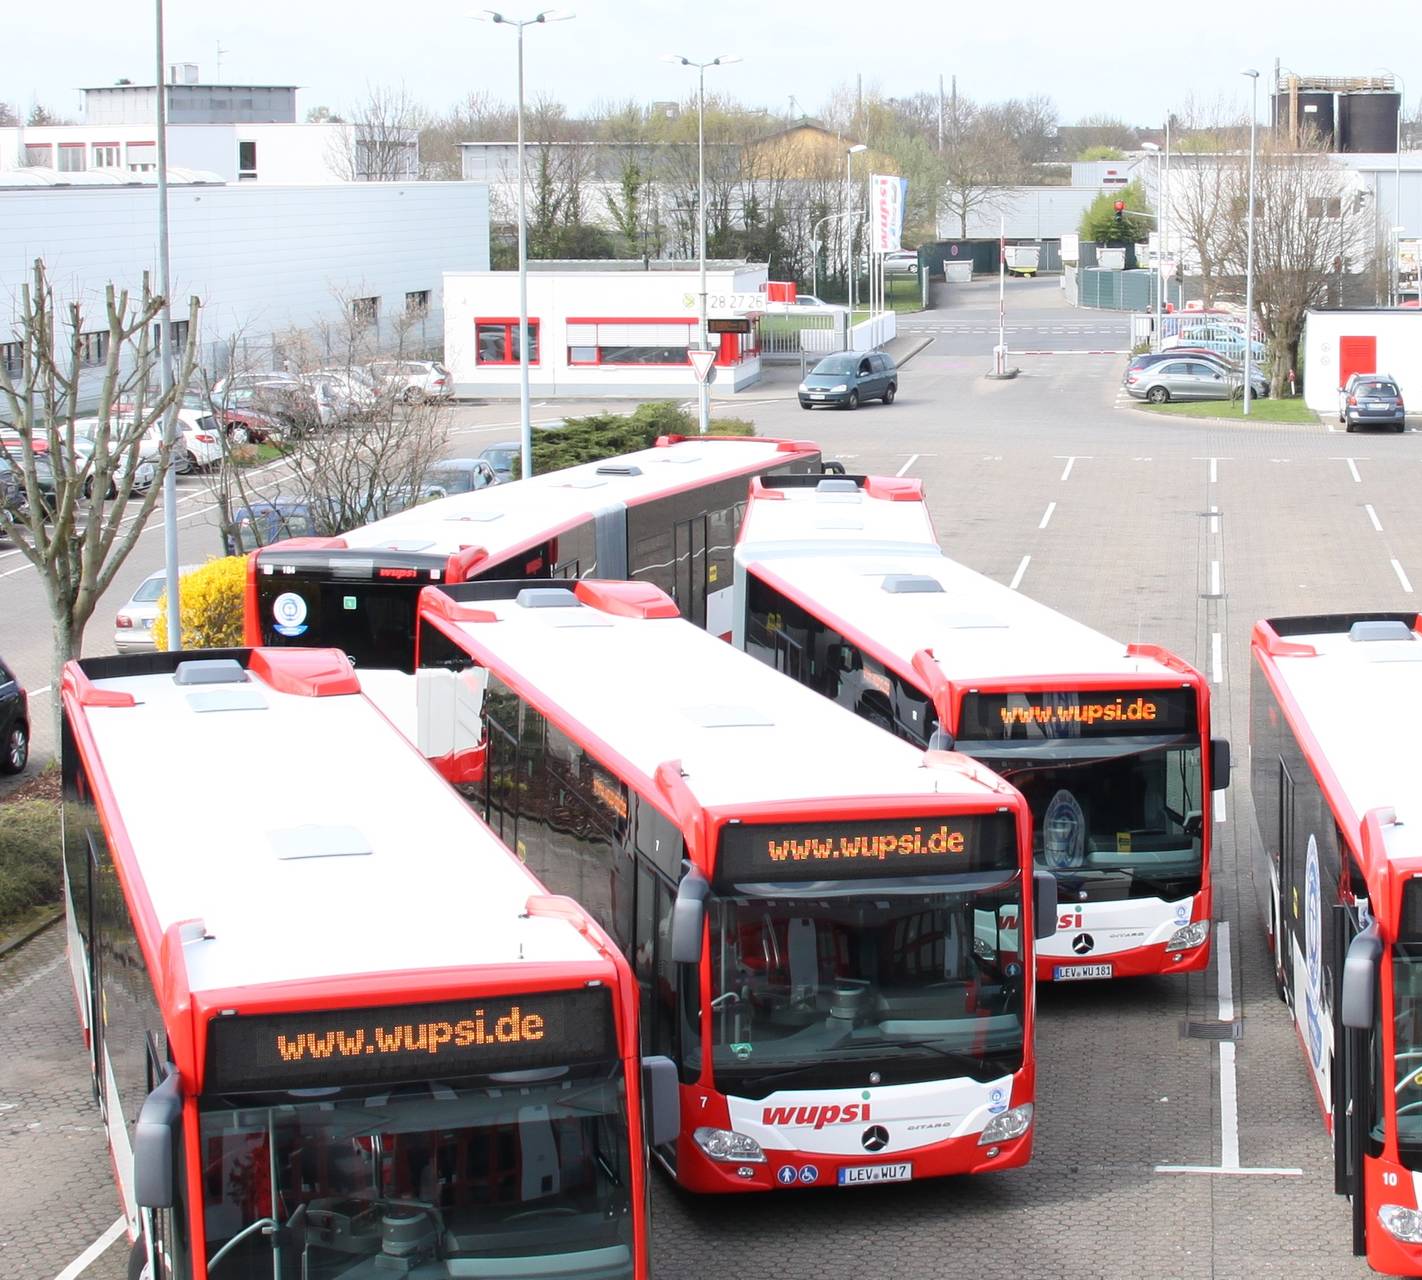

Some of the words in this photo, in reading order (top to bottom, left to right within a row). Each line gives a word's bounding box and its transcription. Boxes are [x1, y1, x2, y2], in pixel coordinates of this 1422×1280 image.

[710, 295, 726, 309] 28
[729, 295, 745, 309] 27
[748, 294, 763, 308] 26
[379, 566, 418, 580] wupsi
[1000, 697, 1157, 725] www.wupsi.de
[768, 825, 965, 861] www.wupsi.de
[1059, 967, 1076, 979] LEV
[1083, 967, 1094, 977] WU
[1095, 965, 1111, 976] 181
[277, 1006, 545, 1062] www.wupsi.de
[700, 1096, 708, 1109] 7
[762, 1090, 871, 1130] wupsi
[849, 1169, 873, 1182] LEV
[881, 1167, 899, 1179] WU
[899, 1165, 906, 1177] 7
[1382, 1172, 1398, 1186] 10
